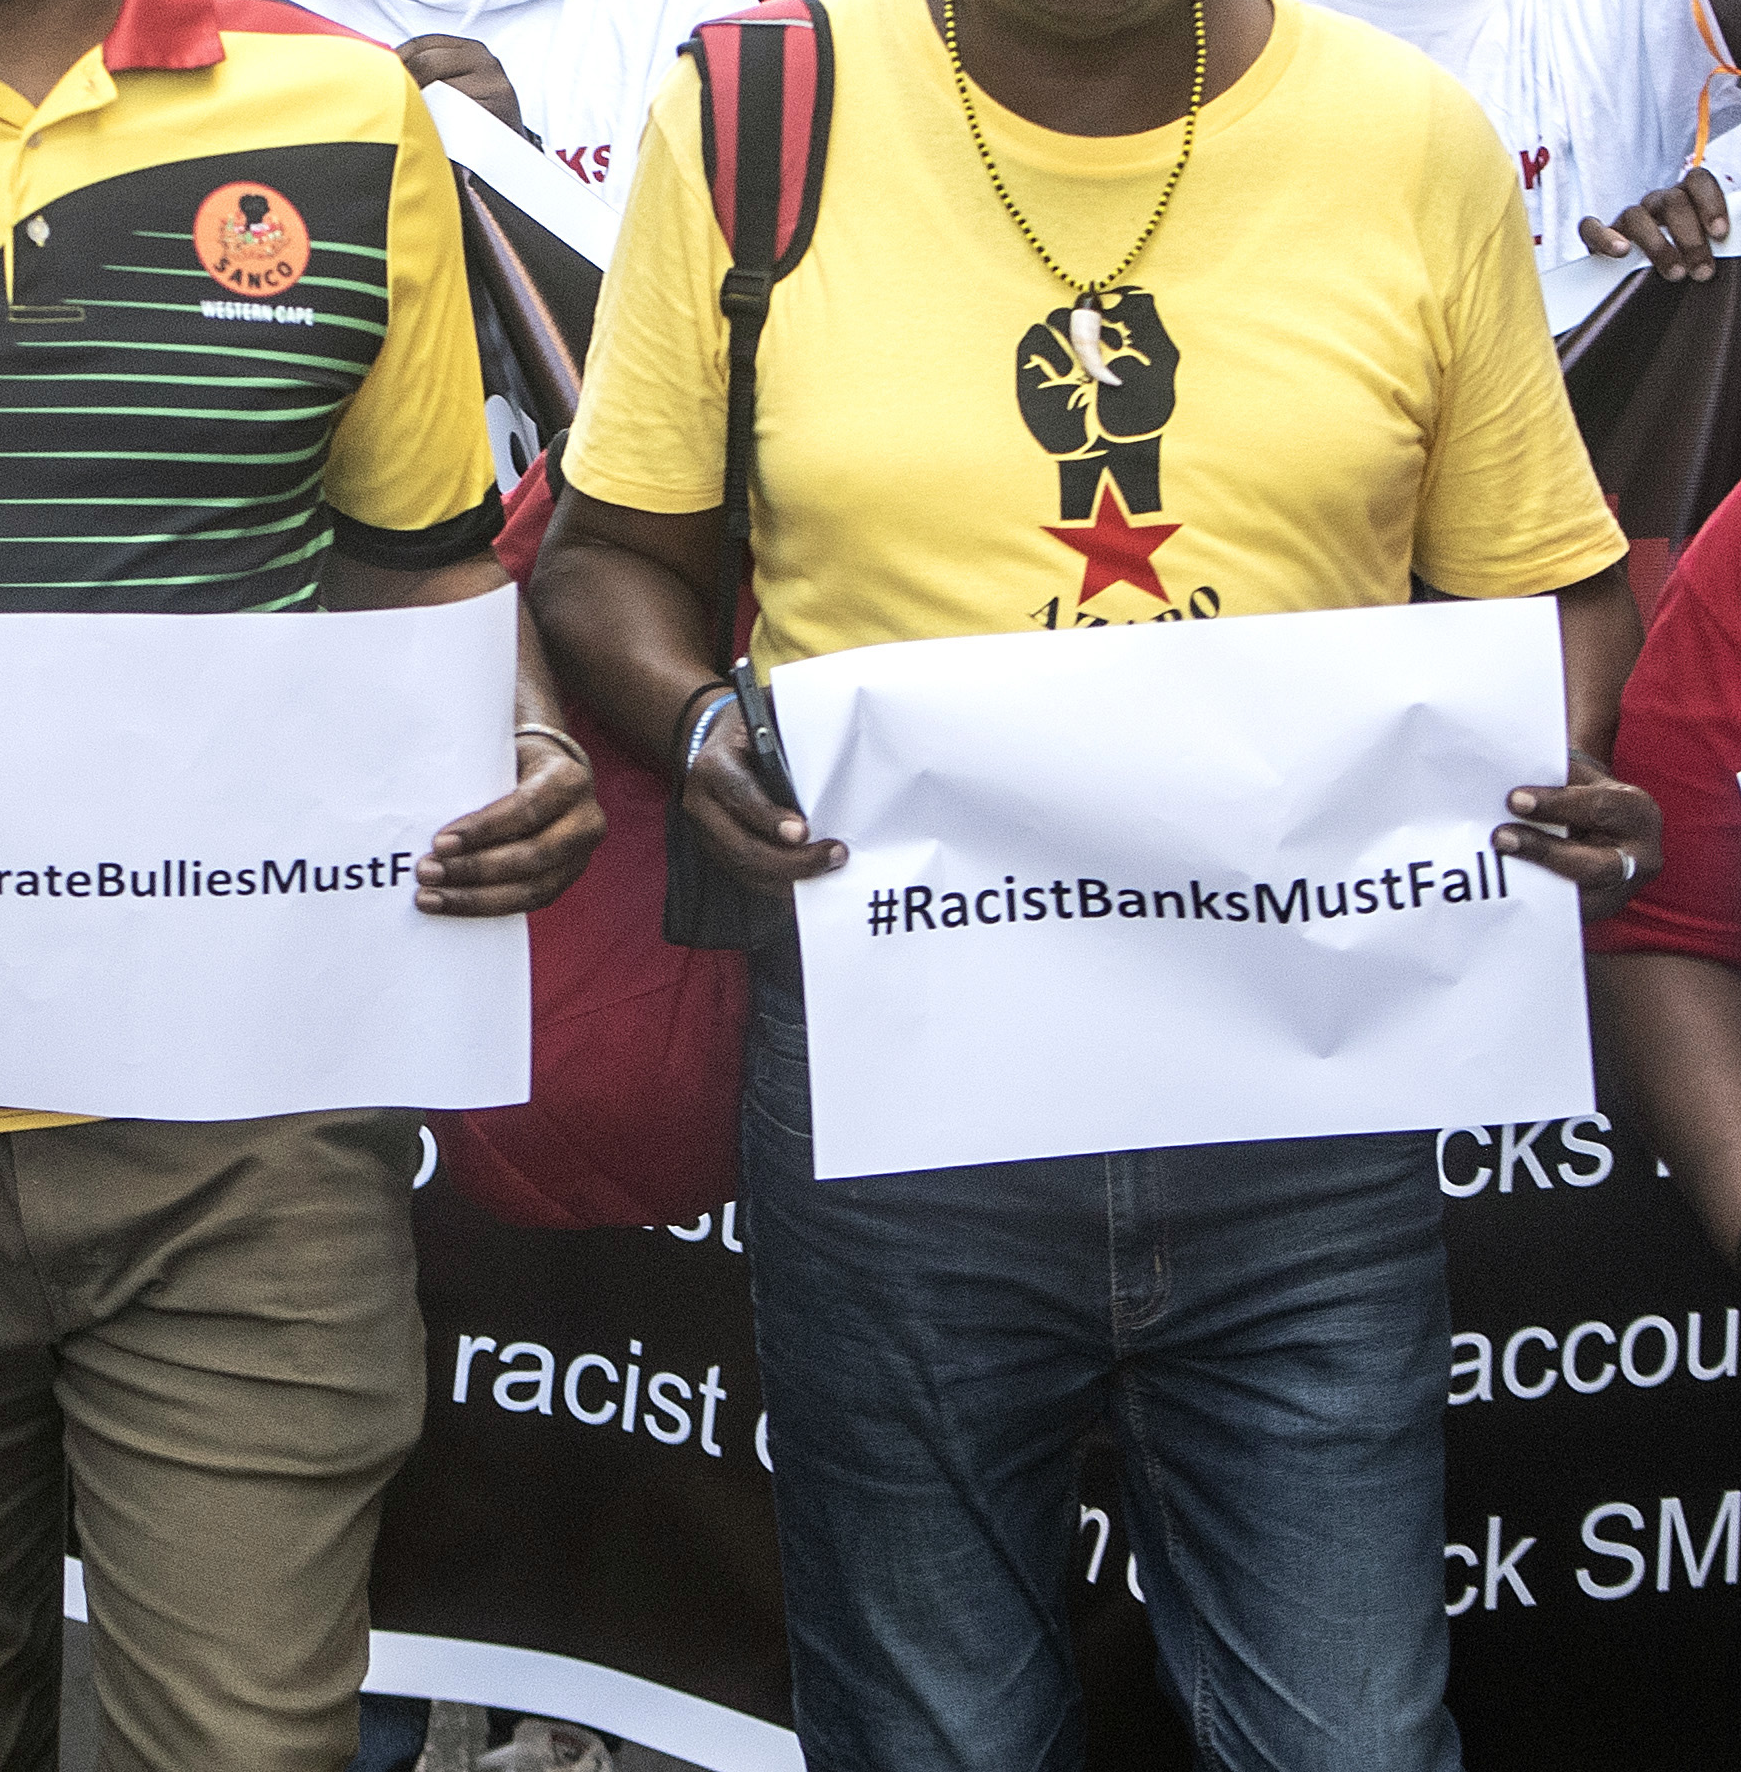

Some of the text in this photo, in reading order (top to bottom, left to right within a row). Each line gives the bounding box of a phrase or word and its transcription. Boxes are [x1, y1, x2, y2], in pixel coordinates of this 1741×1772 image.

[213, 256, 294, 290] SANCO
[867, 850, 1511, 937] #RacistBanksMustFall
[452, 1333, 728, 1459] racist
